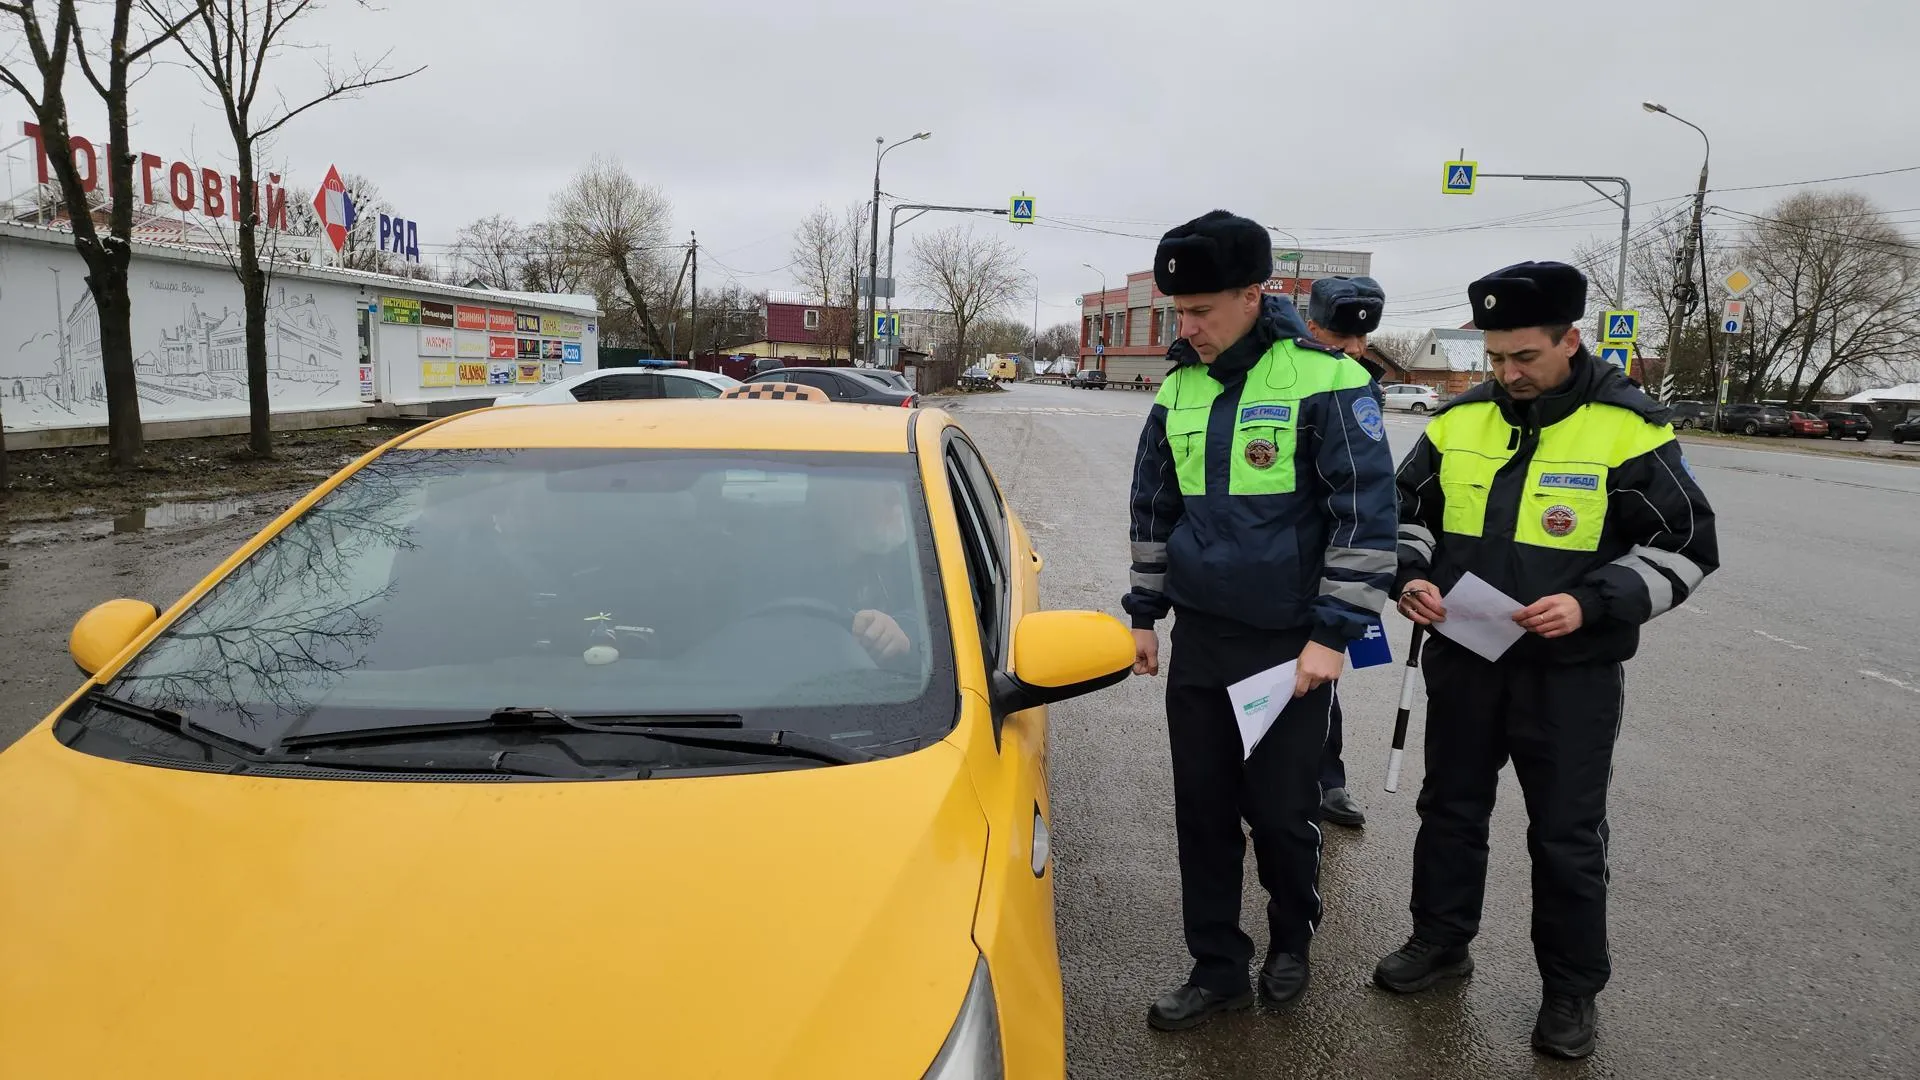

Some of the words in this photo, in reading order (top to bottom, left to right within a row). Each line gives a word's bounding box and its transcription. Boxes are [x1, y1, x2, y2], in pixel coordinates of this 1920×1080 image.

[379, 213, 419, 263] РЯД
[458, 311, 485, 324] СВИНИНА
[490, 314, 514, 326] ГОВЯДИНА
[1243, 409, 1259, 419] ДПС
[1260, 408, 1287, 418] ГИБДД
[1542, 475, 1561, 484] ДПС
[1564, 476, 1595, 487] ГИБДД
